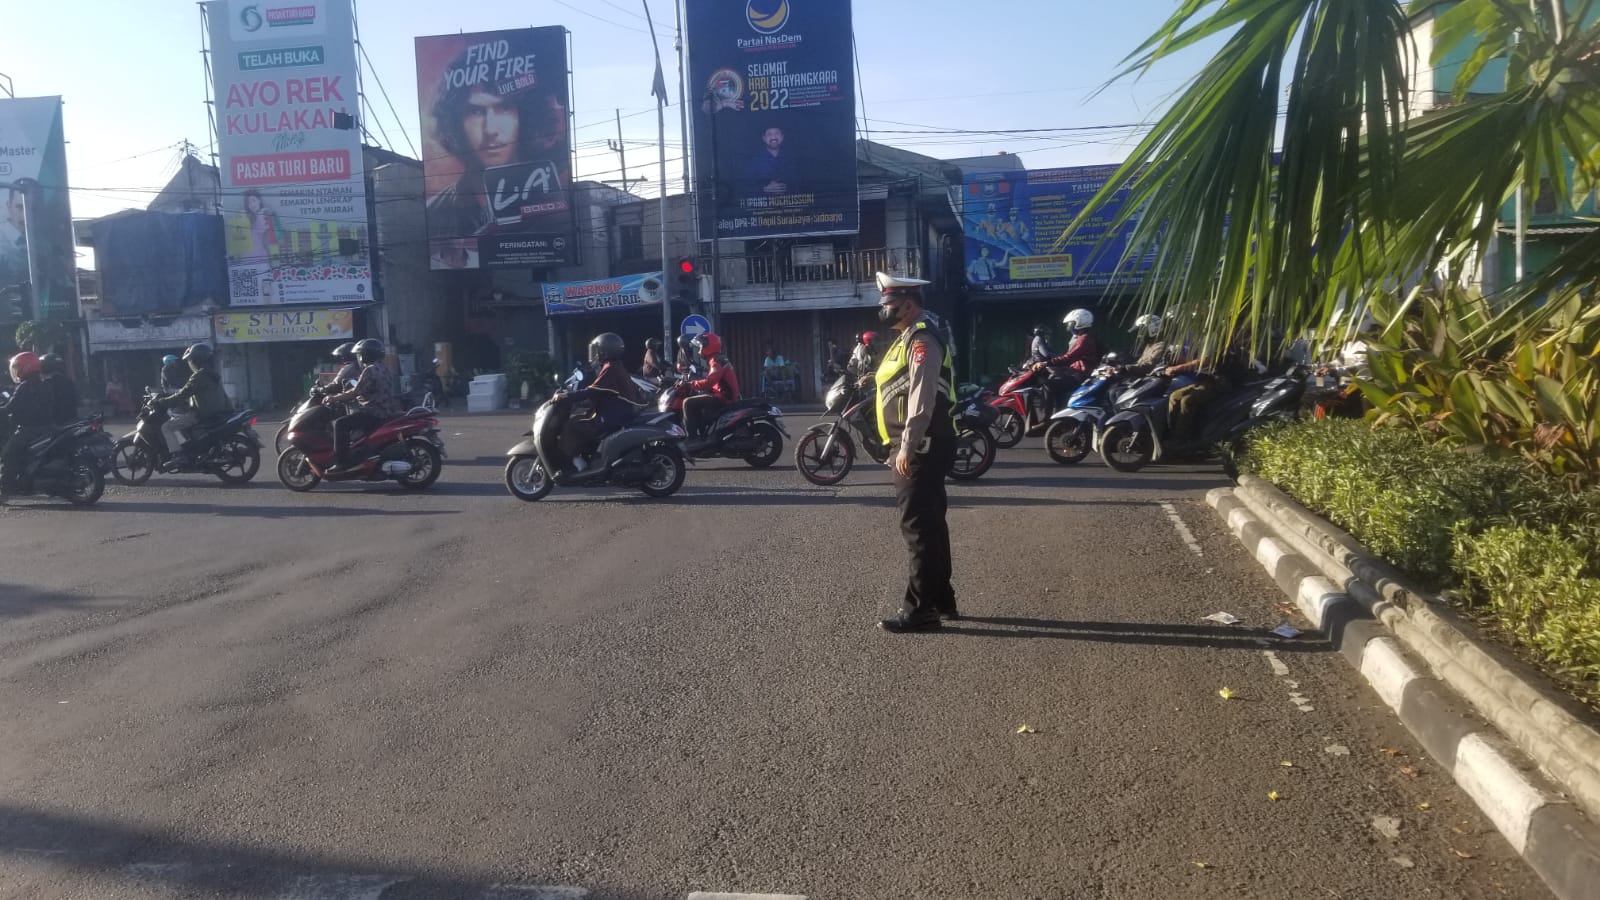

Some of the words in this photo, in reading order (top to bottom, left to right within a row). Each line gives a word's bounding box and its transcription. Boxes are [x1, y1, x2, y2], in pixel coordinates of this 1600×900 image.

[737, 36, 763, 47] Partai
[765, 34, 802, 45] NasDem
[243, 52, 282, 67] TELAH
[284, 50, 319, 64] BUKA
[466, 40, 509, 65] FIND
[444, 64, 489, 90] YOUR
[494, 54, 536, 81] FIRE
[748, 61, 788, 77] SELAMAT
[498, 82, 515, 95] LIVE
[515, 74, 535, 88] BOLD
[748, 77, 769, 91] HARI
[771, 70, 838, 88] BHAYANGKARA
[226, 80, 280, 109] AYO
[286, 75, 344, 104] REK
[750, 88, 789, 111] 2022
[0, 146, 36, 157] Master
[236, 161, 276, 179] PASAR
[278, 158, 306, 176] TURI
[310, 157, 344, 174] BARU
[280, 198, 314, 206] SEMAKIN
[323, 205, 354, 214] MURAH
[524, 203, 555, 213] BOLD
[718, 219, 734, 230] aleg
[564, 282, 622, 297] WARKOP
[586, 298, 613, 309] CAK
[249, 312, 315, 327] STMJ
[248, 328, 278, 336] BANG
[282, 326, 320, 335] HUSIN
